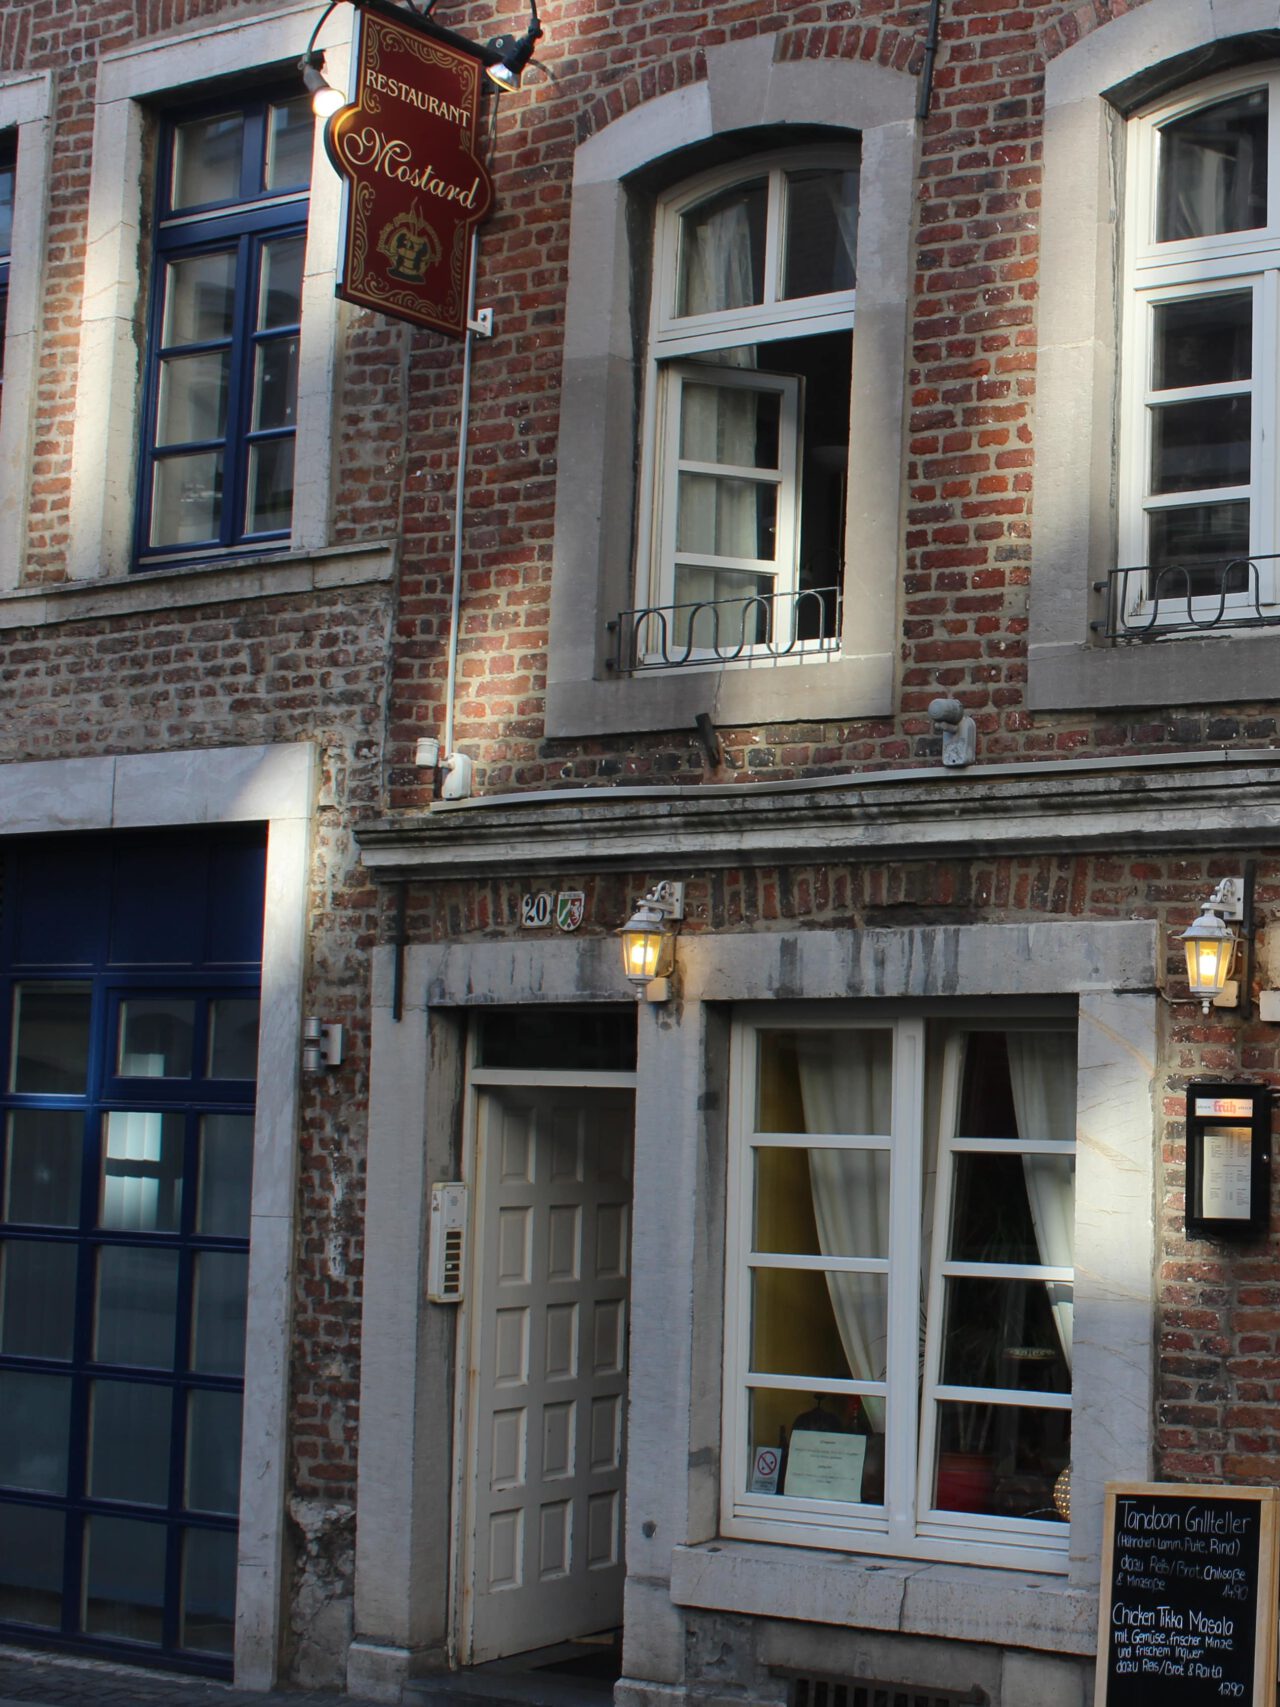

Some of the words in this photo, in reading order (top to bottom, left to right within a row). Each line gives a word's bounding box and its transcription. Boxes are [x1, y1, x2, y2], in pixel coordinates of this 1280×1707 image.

[366, 68, 471, 128] RESTAURANT
[343, 126, 480, 209] Mostard
[523, 894, 548, 923] 20
[1185, 1505, 1252, 1535] Grillteller
[1112, 1602, 1155, 1626] Chicken
[1156, 1606, 1183, 1629] Tikka
[1189, 1609, 1234, 1636] Masala
[1114, 1628, 1129, 1644] mit
[1117, 1646, 1132, 1658] und
[1135, 1644, 1171, 1657] frischem
